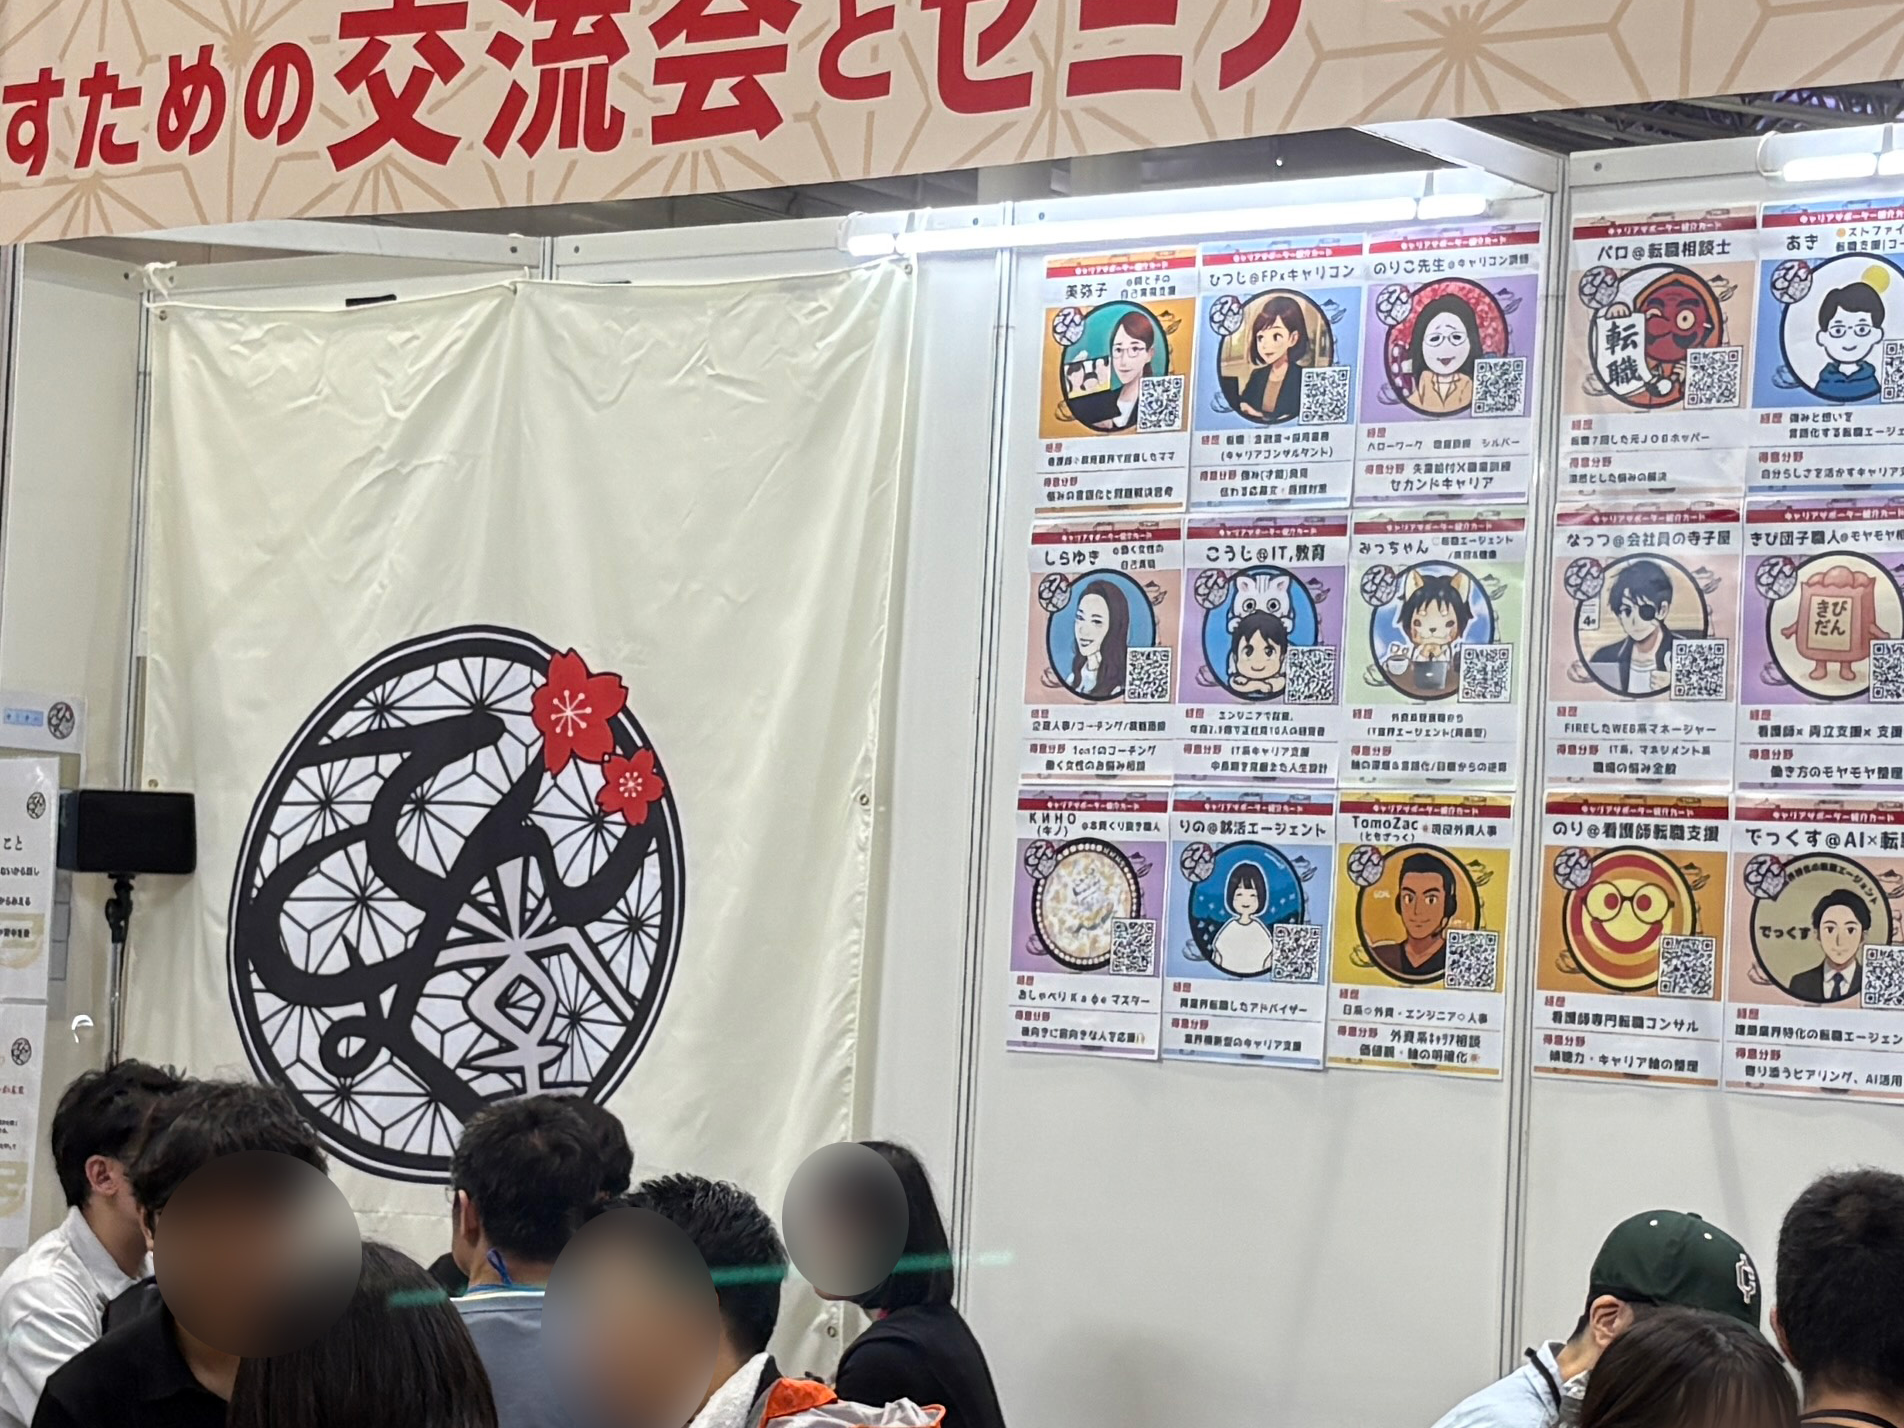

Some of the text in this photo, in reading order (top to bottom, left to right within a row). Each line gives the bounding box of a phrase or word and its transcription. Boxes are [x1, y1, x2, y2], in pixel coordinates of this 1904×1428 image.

[1848, 224, 1904, 237] ストファイ
[1786, 234, 1819, 251] あき
[1603, 319, 1644, 389] 転職
[1367, 438, 1520, 451] ハローワーク シルバー
[1390, 476, 1494, 492] セカンドキャリア
[1566, 530, 1731, 549] なっつ@会社員の寺子屋
[1358, 541, 1428, 556] みっちゃん
[1044, 550, 1100, 567] しらゆき
[1814, 598, 1851, 617] きび
[1813, 618, 1848, 637] だん
[1564, 723, 1716, 735] FIREしたWEB系マネージャー
[1770, 765, 1904, 780] 働き方のモヤモヤ整理
[1180, 819, 1327, 837] りの@就活エージェント
[1352, 816, 1419, 831] TomoZac
[1553, 819, 1720, 842] のり@看護師転職支援
[1758, 924, 1812, 941] でっくす
[1551, 1011, 1699, 1033] 看護師専門転職コンサル
